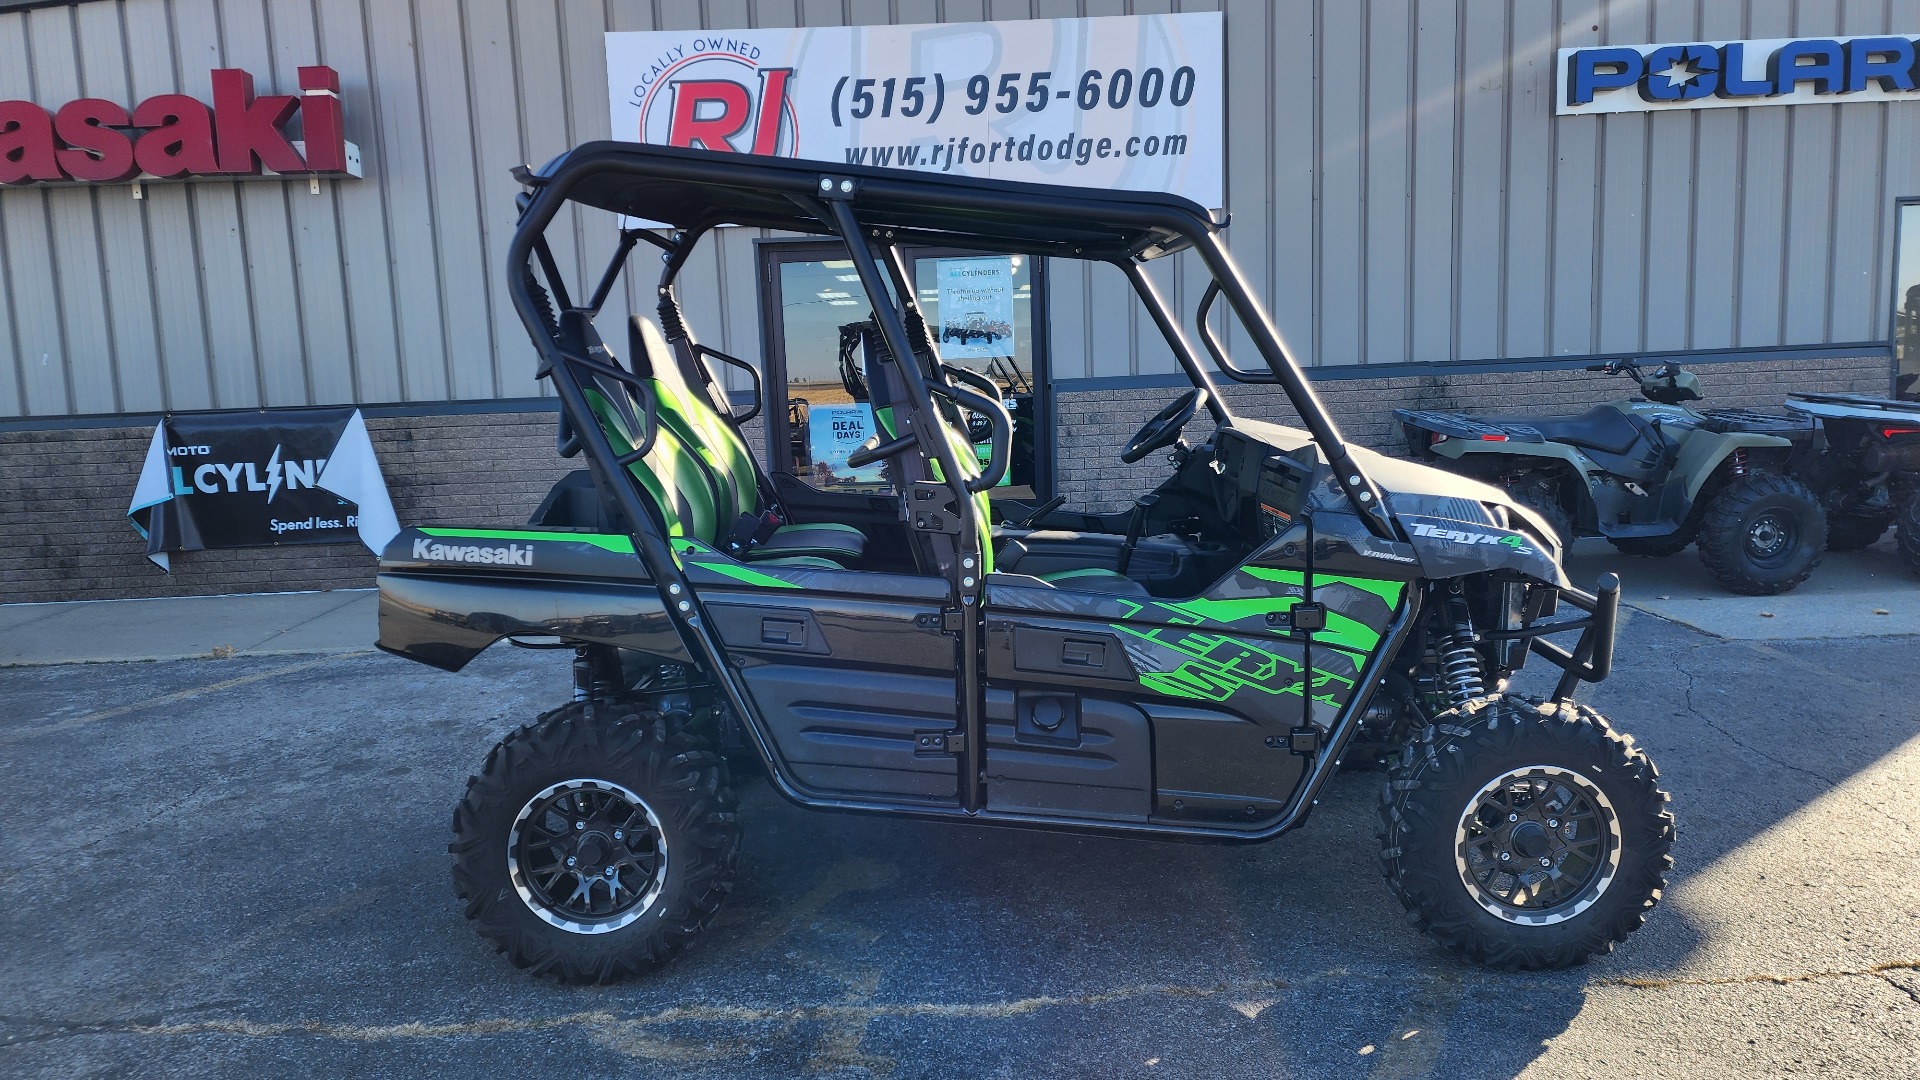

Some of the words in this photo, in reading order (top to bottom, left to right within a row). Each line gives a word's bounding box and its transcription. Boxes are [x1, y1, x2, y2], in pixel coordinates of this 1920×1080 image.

[629, 44, 684, 108] LOCALLY
[693, 37, 761, 60] OWNED
[830, 72, 944, 126] (515)
[965, 65, 1196, 115] 955-6000
[845, 133, 1188, 171] www.rjfortdodge.com
[833, 421, 864, 430] DEAL
[837, 431, 861, 439] DAYS
[269, 517, 313, 534] Spend
[316, 516, 343, 529] less.
[412, 538, 534, 566] Kawasaki
